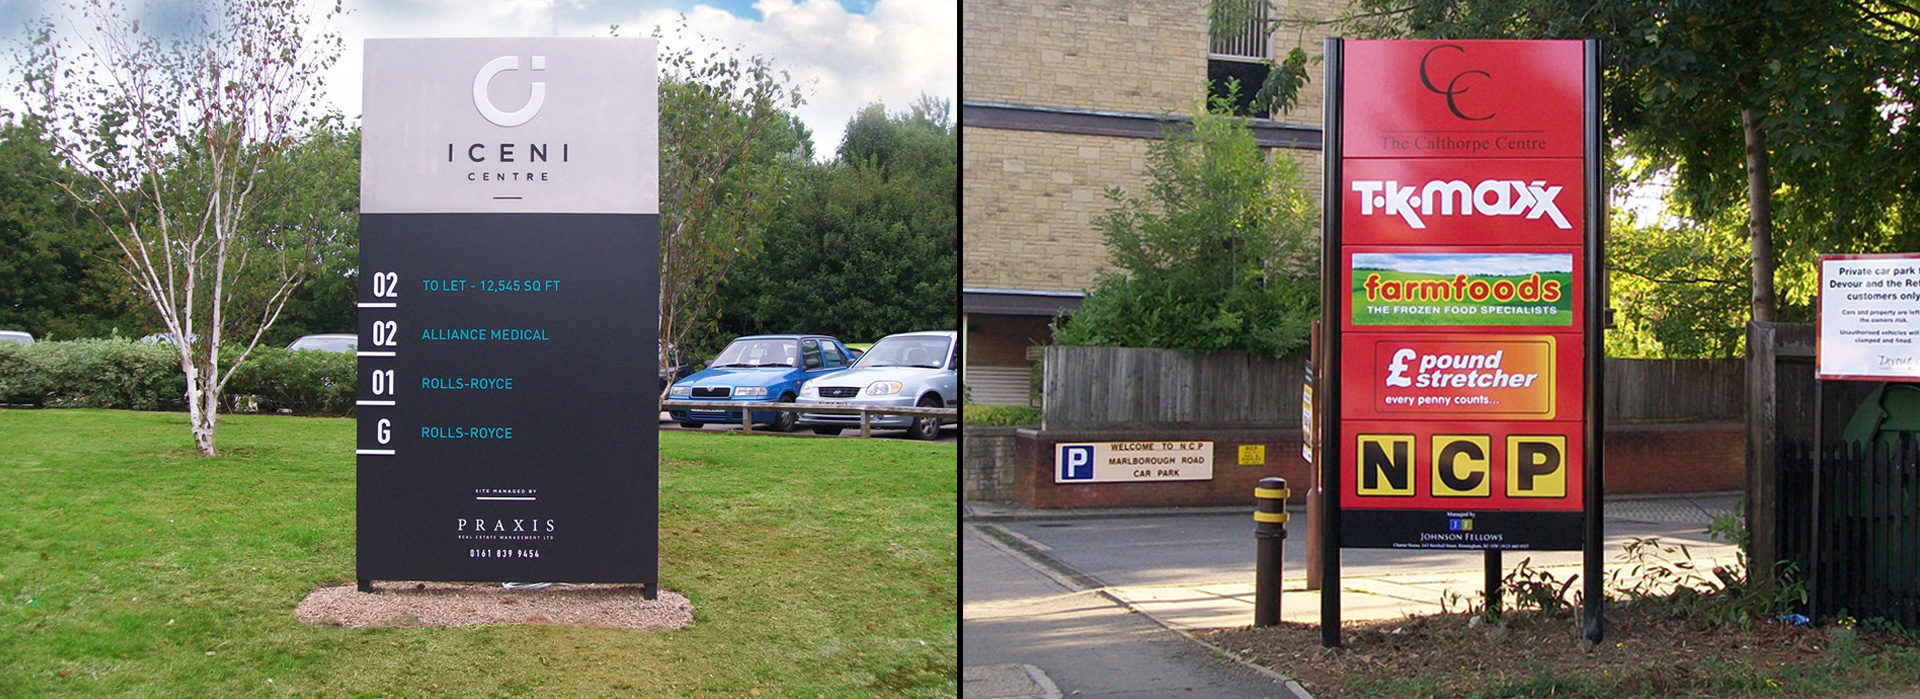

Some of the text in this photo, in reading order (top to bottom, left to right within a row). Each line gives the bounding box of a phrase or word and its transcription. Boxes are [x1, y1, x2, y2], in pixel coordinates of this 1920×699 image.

[1381, 135, 1546, 153] The Calthorpe Centre
[448, 143, 568, 162] ICENI
[467, 172, 549, 181] CENTRE
[1839, 267, 1872, 276] Private
[1893, 266, 1915, 276] park
[373, 271, 398, 298] 02
[423, 280, 439, 292] TO
[442, 280, 467, 292] LET
[480, 280, 521, 293] 12,545
[523, 281, 541, 292] SQ
[545, 281, 561, 292] FT
[1363, 273, 1562, 303] farmfoods
[1830, 280, 1863, 288] Devour
[1866, 280, 1884, 288] and
[1886, 279, 1902, 288] the
[1367, 305, 1558, 315] THE FROZEN FOOD SPECIALISTS
[372, 320, 397, 346] 02
[421, 329, 550, 341] ALLIANCE MEDICAL
[1386, 348, 1503, 388] £ pound
[372, 369, 394, 395] 01
[421, 378, 513, 390] ROLLS-ROYCE
[1415, 369, 1539, 388] stretcher
[1385, 395, 1414, 405] every
[1417, 395, 1450, 406] penny
[377, 418, 391, 445] G
[421, 427, 513, 439] ROLLS-ROYCE
[1111, 443, 1154, 451] WELCOME
[1067, 447, 1087, 477] P
[1109, 457, 1175, 465] MARLBOROUGH
[457, 518, 555, 532] PRAXIS
[1420, 532, 1503, 541] JOHNSON FELLOWS
[469, 549, 540, 558] 0161 839 9454
